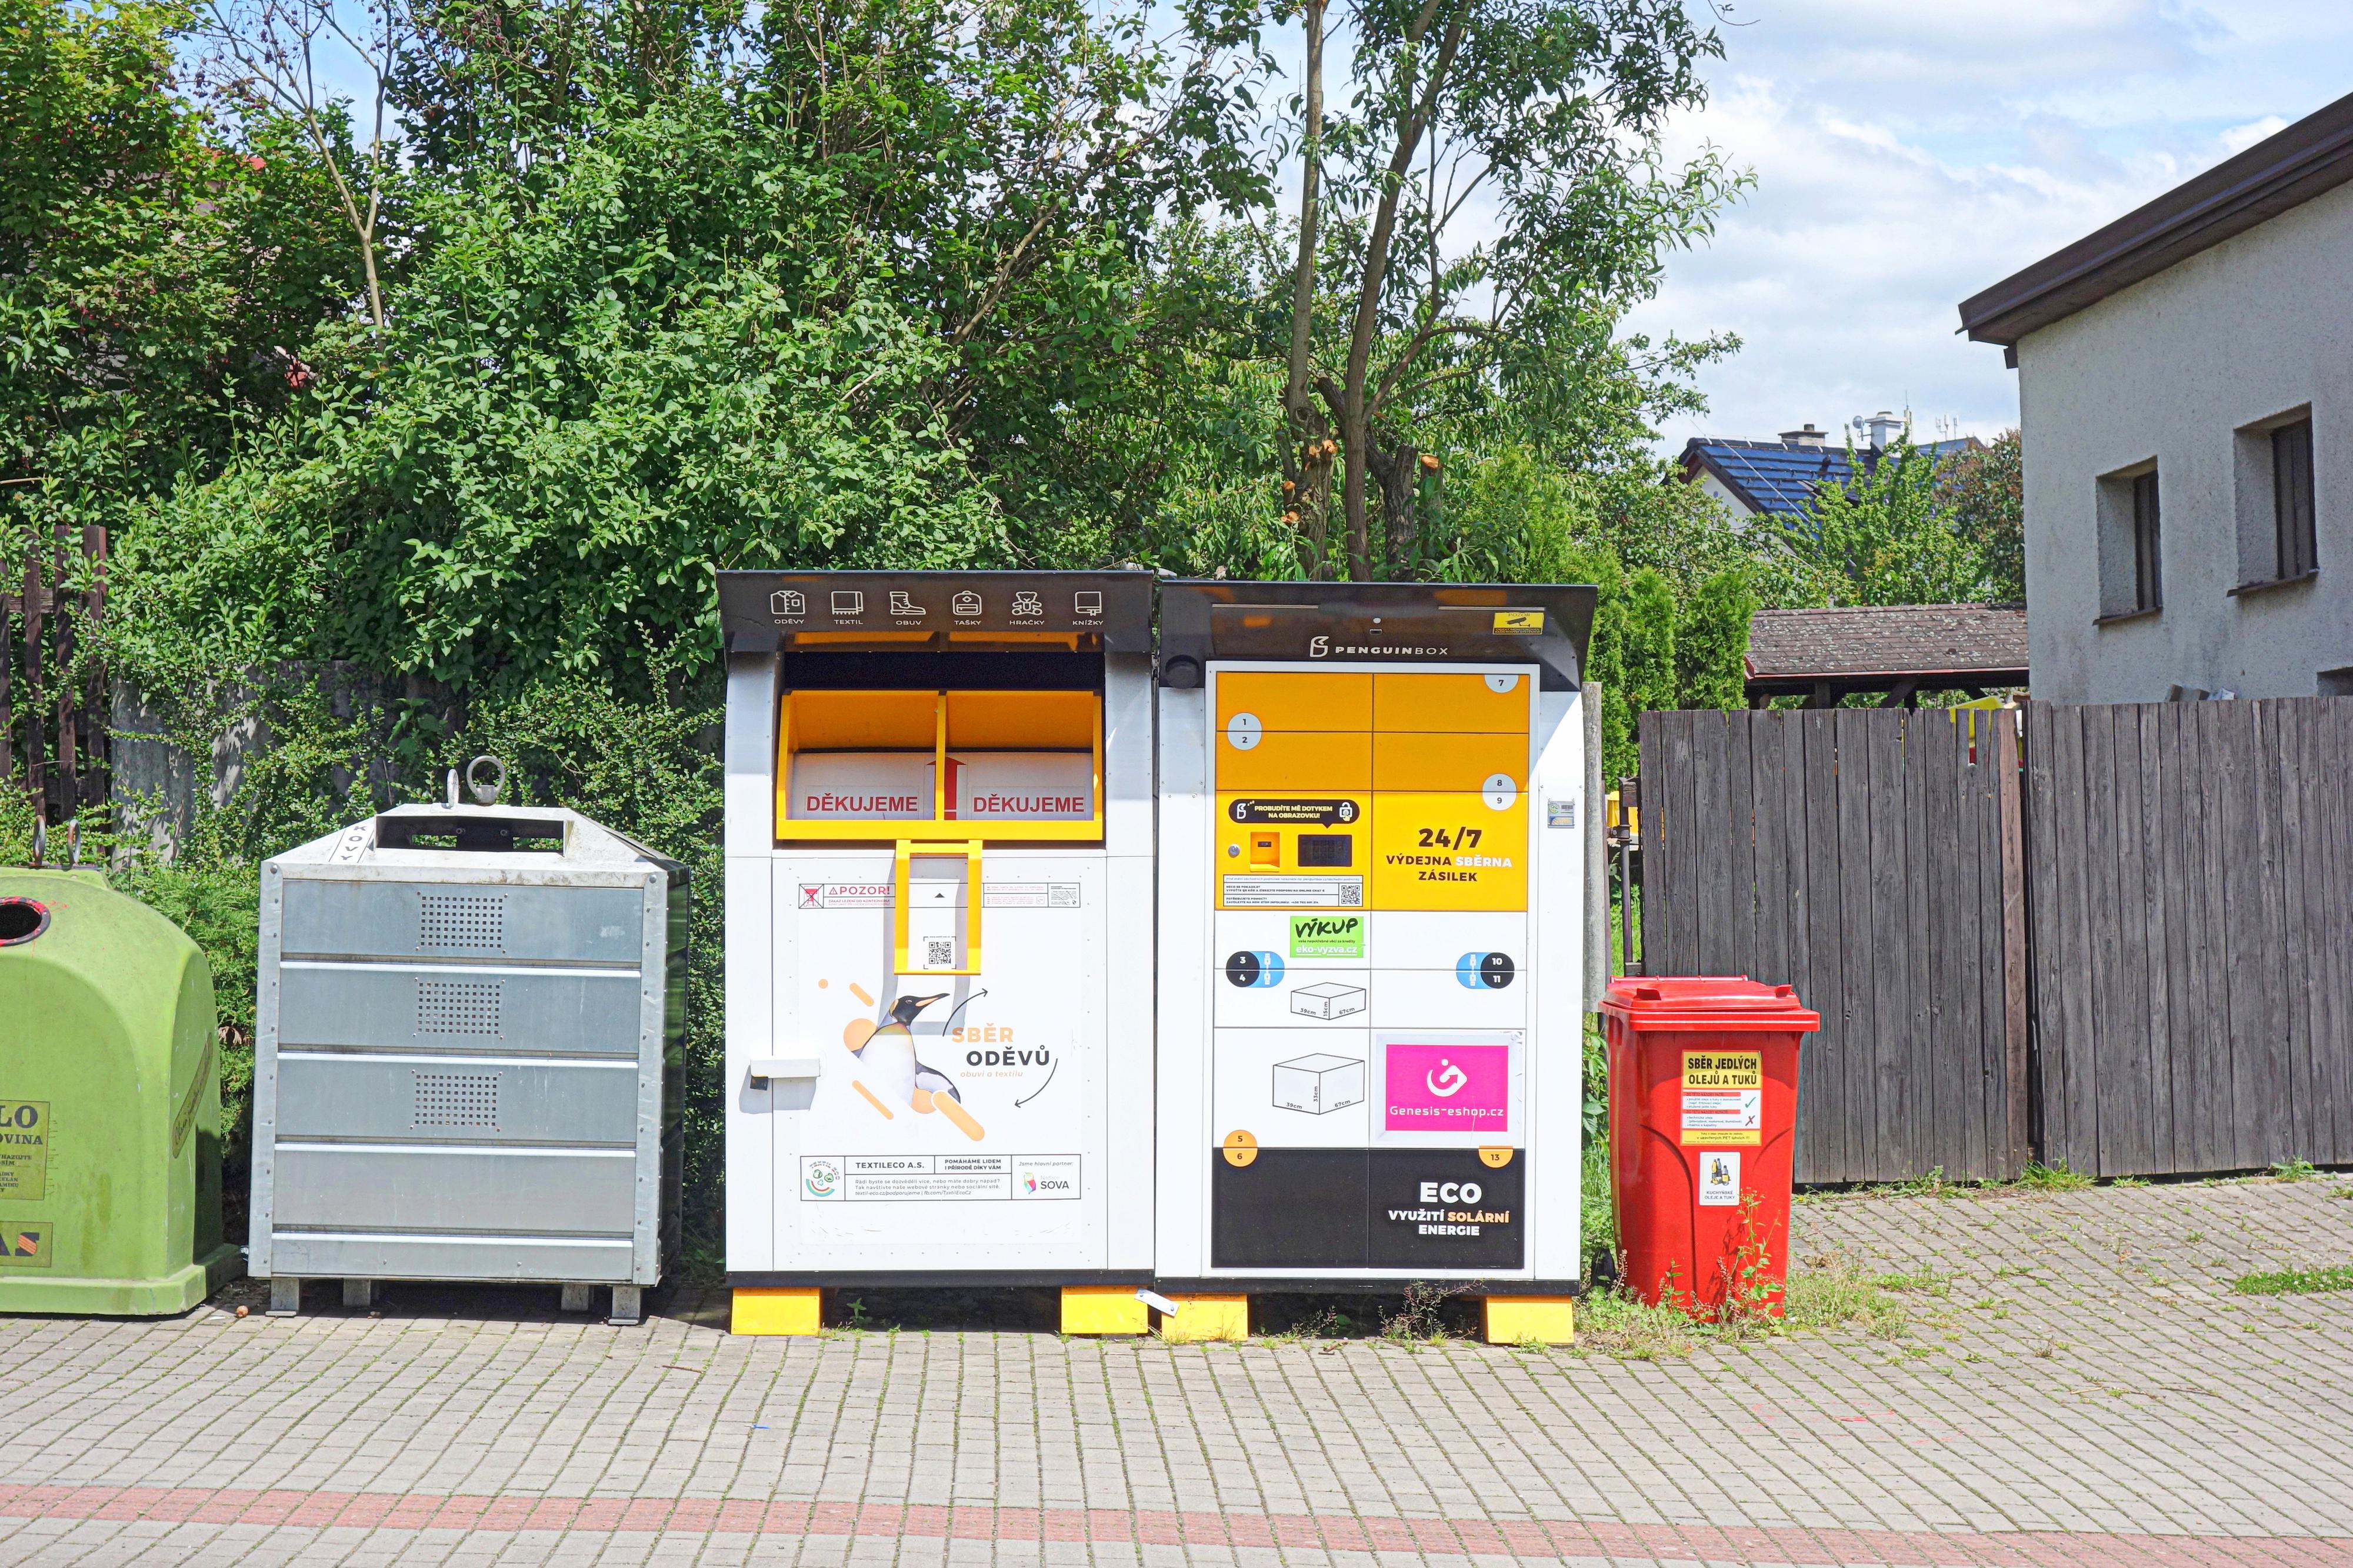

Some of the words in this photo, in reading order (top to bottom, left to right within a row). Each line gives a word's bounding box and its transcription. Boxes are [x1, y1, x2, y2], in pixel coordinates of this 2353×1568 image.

[1335, 646, 1448, 655] PENGUINBOX
[806, 793, 918, 812] DĚKUJEME
[973, 793, 1085, 812] DĚKUJEME
[340, 826, 367, 860] KOVY
[1418, 826, 1482, 850] 24/7
[1386, 853, 1452, 866] VÝDEJNA
[1455, 855, 1512, 868] SBĚRNA
[1418, 869, 1478, 882] ZÁSILEK
[839, 886, 890, 895] POZOR!
[1295, 918, 1358, 938] VÝKUP
[1296, 945, 1358, 954] eko-vyzva.cz
[951, 1023, 1014, 1043] SBĚR
[966, 1045, 1049, 1066] ODĚVŮ
[1688, 1055, 1712, 1069] SBĚR
[1715, 1055, 1757, 1069] JEDLÝCH
[1689, 1070, 1719, 1084] OLEJŮ
[1722, 1075, 1729, 1085] A
[1732, 1070, 1757, 1085] TUKŮ
[1335, 1099, 1351, 1107] 67cm
[1389, 1106, 1504, 1117] Genesis-eshop.cz
[1041, 1180, 1069, 1189] SOVA
[1419, 1182, 1482, 1204] ECO
[1388, 1208, 1445, 1222] VYUŽITÍ
[1447, 1210, 1510, 1223] SOLÁRNÍ
[1418, 1225, 1480, 1236] ENERGIE
